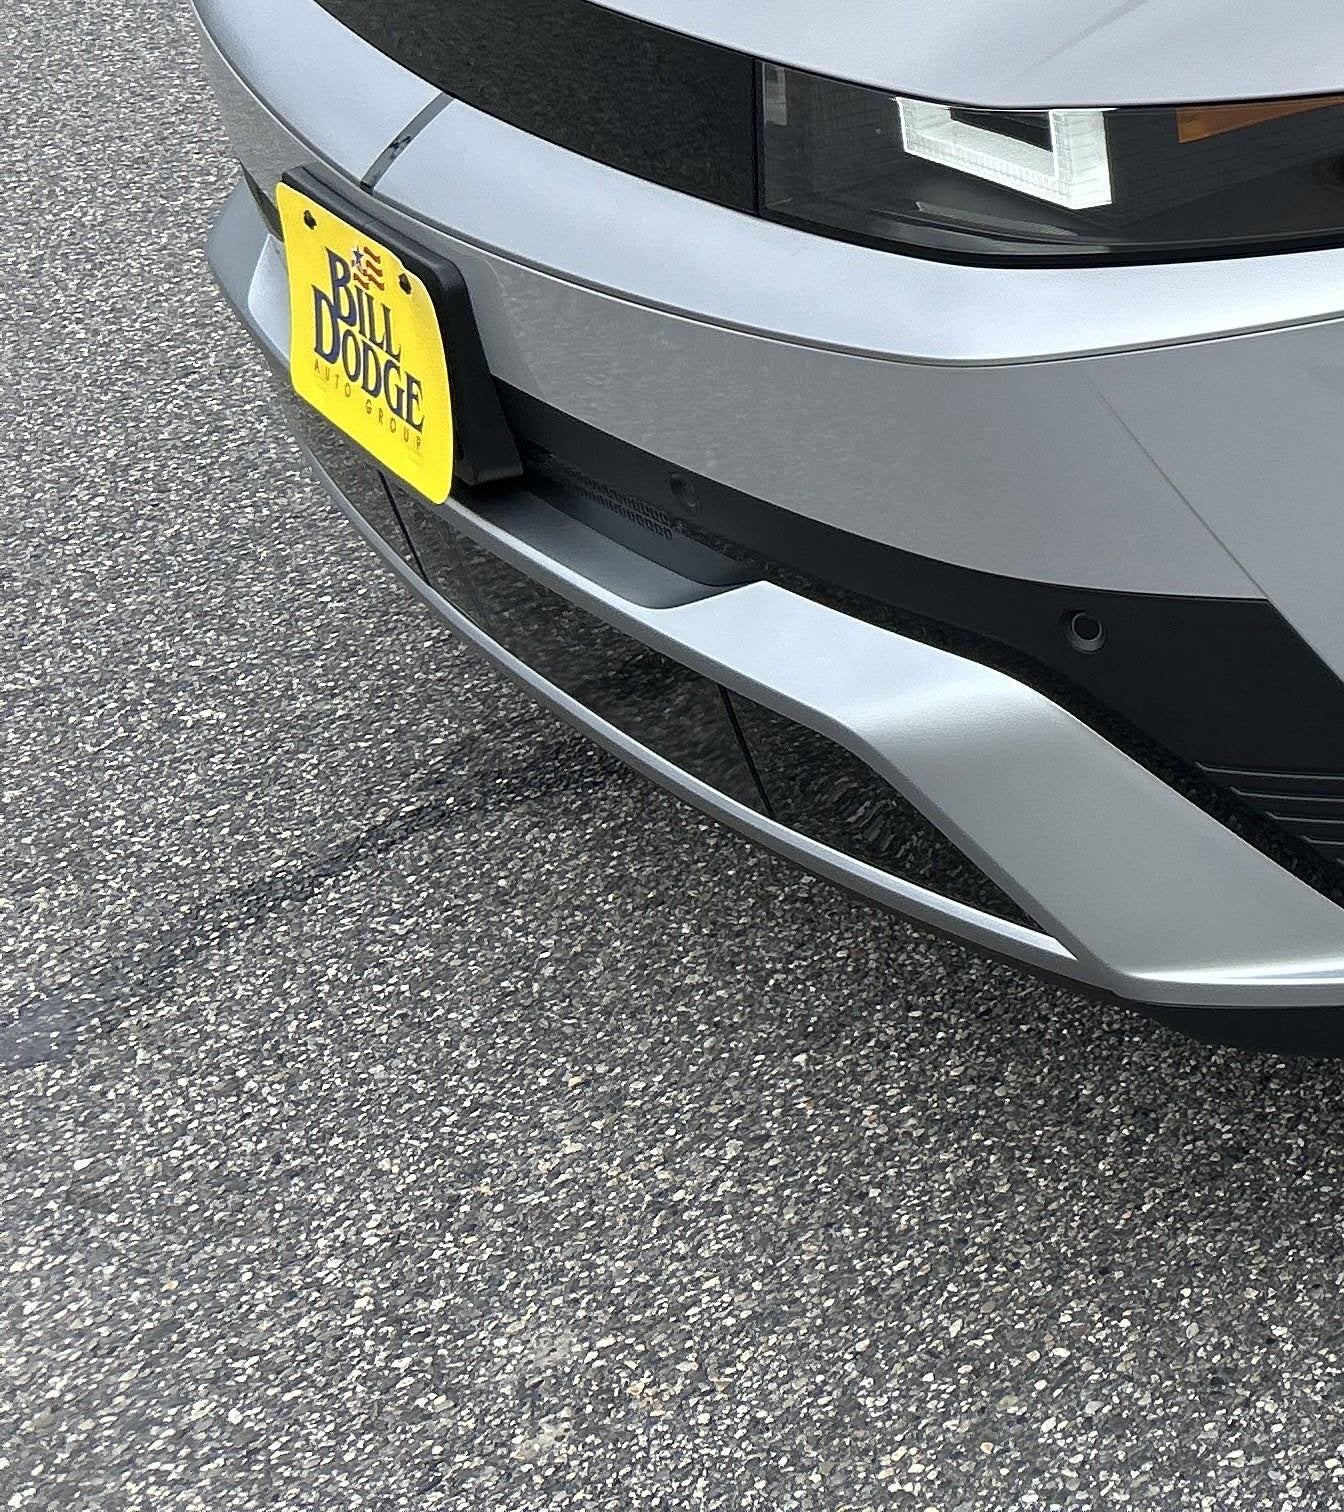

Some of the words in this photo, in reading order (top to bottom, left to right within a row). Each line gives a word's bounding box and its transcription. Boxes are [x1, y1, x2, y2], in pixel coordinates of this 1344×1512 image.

[311, 284, 425, 433] DODGE
[325, 246, 402, 364] BILL
[314, 359, 352, 398] AUTO
[365, 399, 424, 451] GROUP
